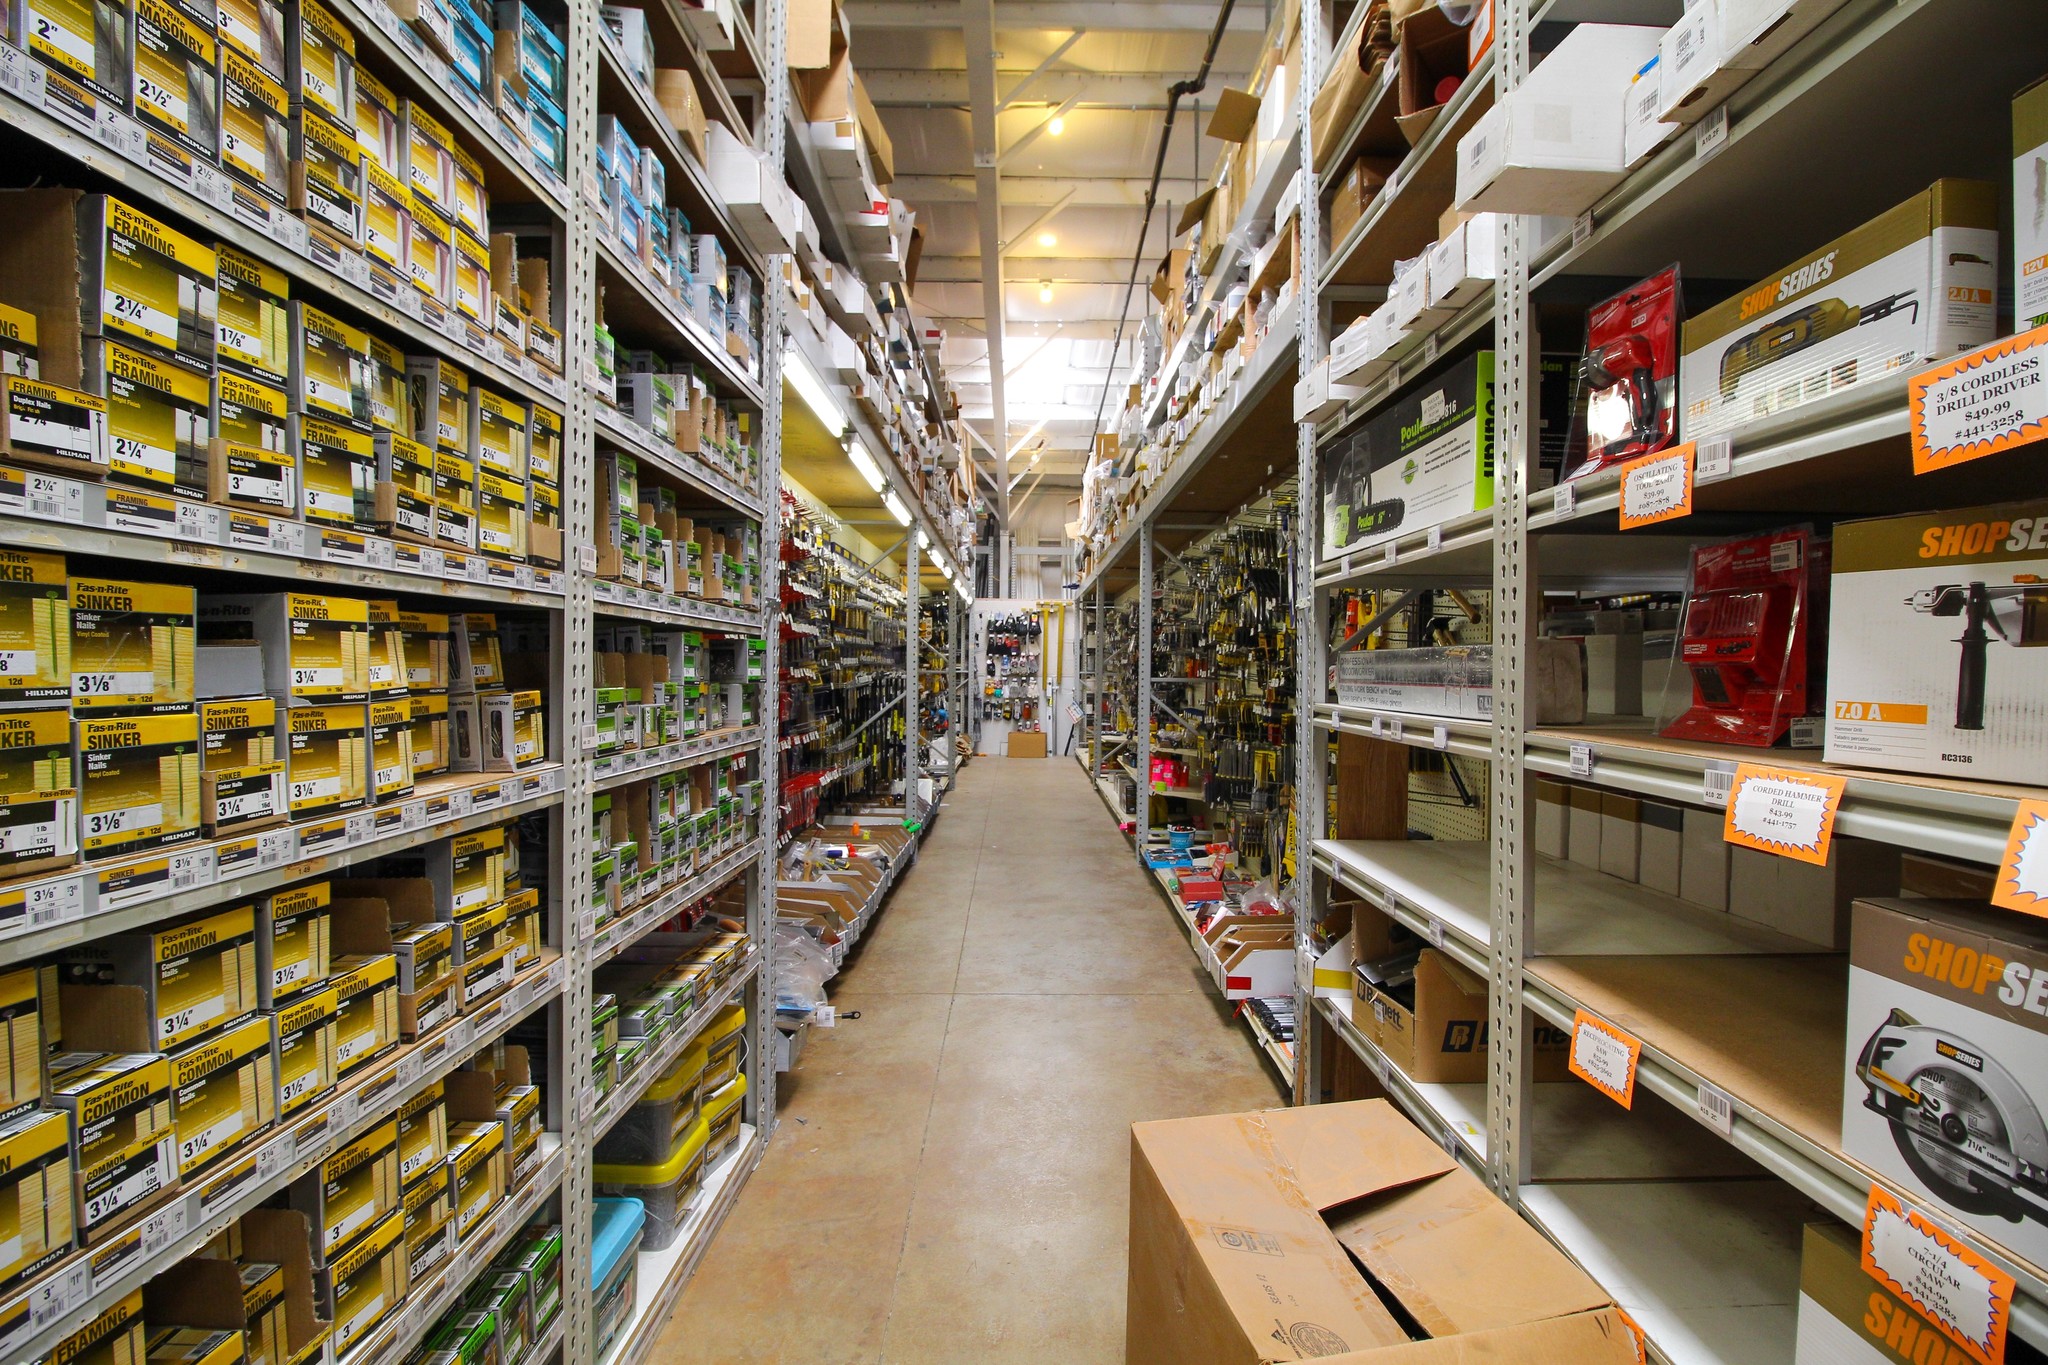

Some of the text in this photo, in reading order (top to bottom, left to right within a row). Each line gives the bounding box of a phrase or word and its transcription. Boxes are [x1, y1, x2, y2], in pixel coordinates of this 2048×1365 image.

[139, 5, 204, 56] MASONRY
[302, 5, 346, 48] MASONRY
[138, 27, 169, 52] Masonry
[75, 61, 89, 75] GA
[253, 61, 281, 85] HILLMAN
[47, 72, 84, 100] MASONRY
[83, 77, 123, 106] HILLMAN
[226, 64, 280, 110] MASONRY
[411, 111, 447, 145] MASONRY
[178, 133, 211, 156] HILLMAN
[305, 124, 351, 159] MASONRY
[256, 182, 284, 201] HILLMAN
[370, 169, 409, 207] MASONRY
[412, 206, 446, 240] MASONRY
[112, 233, 137, 251] Duplex
[113, 217, 176, 259] FRAMING
[112, 242, 131, 256] Nails
[219, 257, 262, 287] SINKER
[2024, 258, 2045, 274] 12V
[219, 272, 238, 286] Sinker
[1949, 288, 1980, 303] 2.0 A
[307, 317, 347, 345] FRAMING
[174, 353, 208, 370] HILLMAN
[112, 376, 136, 392] Duplex
[113, 358, 173, 393] FRAMING
[252, 367, 283, 383] HILLMAN
[1936, 357, 2039, 404] 3/8 CORDLESS
[13, 381, 57, 401] FRAMING
[112, 384, 130, 397] Nails
[221, 385, 273, 413] FRAMING
[1936, 372, 2041, 416] DRILL DRIVER
[13, 395, 52, 410] Duplex Nails
[221, 401, 242, 414] Duplex
[1965, 400, 2011, 422] $49.99
[1955, 409, 2024, 439] #441-3258
[305, 431, 348, 451] FRAMING
[56, 448, 90, 460] HILLMAN
[230, 447, 260, 461] FRAMING
[393, 445, 418, 463] SINKER
[436, 462, 461, 479] SINKER
[1633, 463, 1678, 482] OSCILLATING
[116, 493, 148, 506] FRAMING
[173, 486, 203, 499] HILLMAN
[1643, 489, 1665, 499] $39.99
[1357, 513, 1375, 529] Poulan
[76, 594, 133, 612] SINKER
[76, 612, 101, 621] Sinker
[293, 607, 329, 619] SINKER
[76, 621, 96, 630] Nails
[25, 689, 68, 697] HILLMAN
[152, 704, 189, 713] HILLMAN
[1837, 703, 1882, 720] 7.0 A
[206, 716, 249, 730] SINKER
[292, 719, 327, 731] SINKER
[373, 712, 403, 726] COMMON
[88, 732, 141, 750] SINKER
[206, 733, 226, 741] Sinker
[88, 753, 112, 762] Sinker
[88, 761, 107, 770] Nails
[1942, 753, 1973, 763] RC3136
[218, 772, 241, 781] SINKER
[1753, 785, 1822, 803] CORDED HAMMER
[1772, 798, 1795, 808] DRILL
[1769, 808, 1793, 819] $43.99
[150, 826, 162, 835] 12d
[1763, 817, 1797, 830] #441-1757
[161, 831, 196, 842] HILLMAN
[16, 847, 54, 857] HILLMAN
[109, 869, 135, 880] SINKER
[275, 896, 318, 918] COMMON
[161, 931, 217, 960] COMMON
[161, 957, 189, 971] Common
[161, 967, 178, 979] Nails
[223, 1013, 252, 1029] HILLMAN
[281, 1006, 325, 1034] COMMON
[1937, 1042, 1981, 1068] SHOPSERIES
[178, 1049, 233, 1085] COMMON
[179, 1079, 206, 1097] Common
[311, 1087, 335, 1104] HILLMAN
[83, 1083, 149, 1123] COMMON
[83, 1116, 115, 1136] Common
[83, 1130, 102, 1145] Nails
[87, 1153, 126, 1181] COMMON
[328, 1147, 370, 1184] FRAMING
[87, 1164, 127, 1191] Common Nails
[128, 1184, 160, 1207] HILLMAN
[21, 1248, 64, 1279] HILLMAN
[337, 1243, 378, 1284] FRAMING
[1923, 1247, 1947, 1269] 7-1/4
[1908, 1246, 1961, 1290] CIRCULAR
[1920, 1267, 1944, 1289] SAW
[1915, 1275, 1949, 1305] $44.99
[1907, 1281, 1957, 1323] #441-3282
